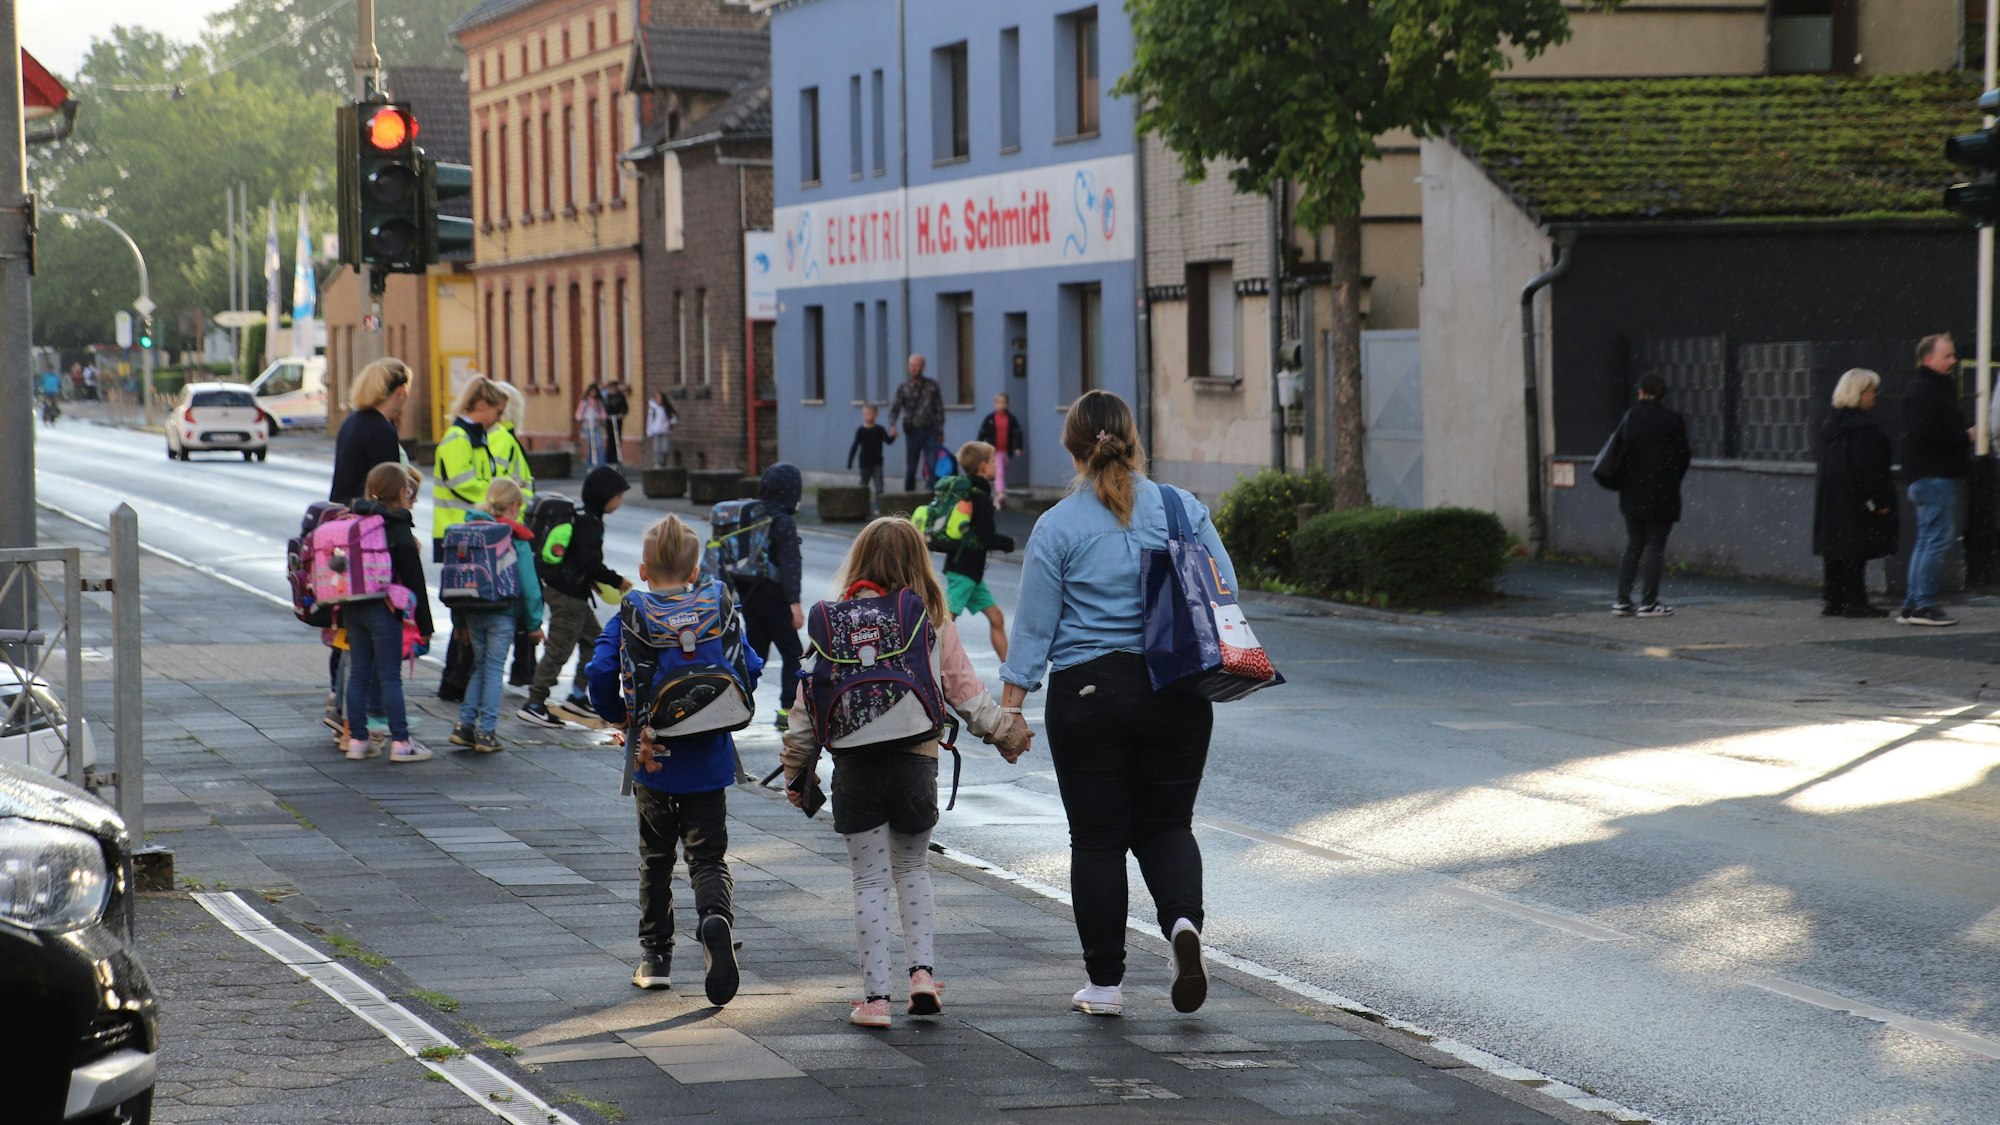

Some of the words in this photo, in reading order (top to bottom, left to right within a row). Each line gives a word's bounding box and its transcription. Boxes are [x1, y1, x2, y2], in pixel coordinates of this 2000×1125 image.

[917, 202, 957, 255] H.G.
[964, 190, 1050, 252] Schmidt
[671, 614, 697, 625] Scout
[853, 630, 878, 642] Scout
